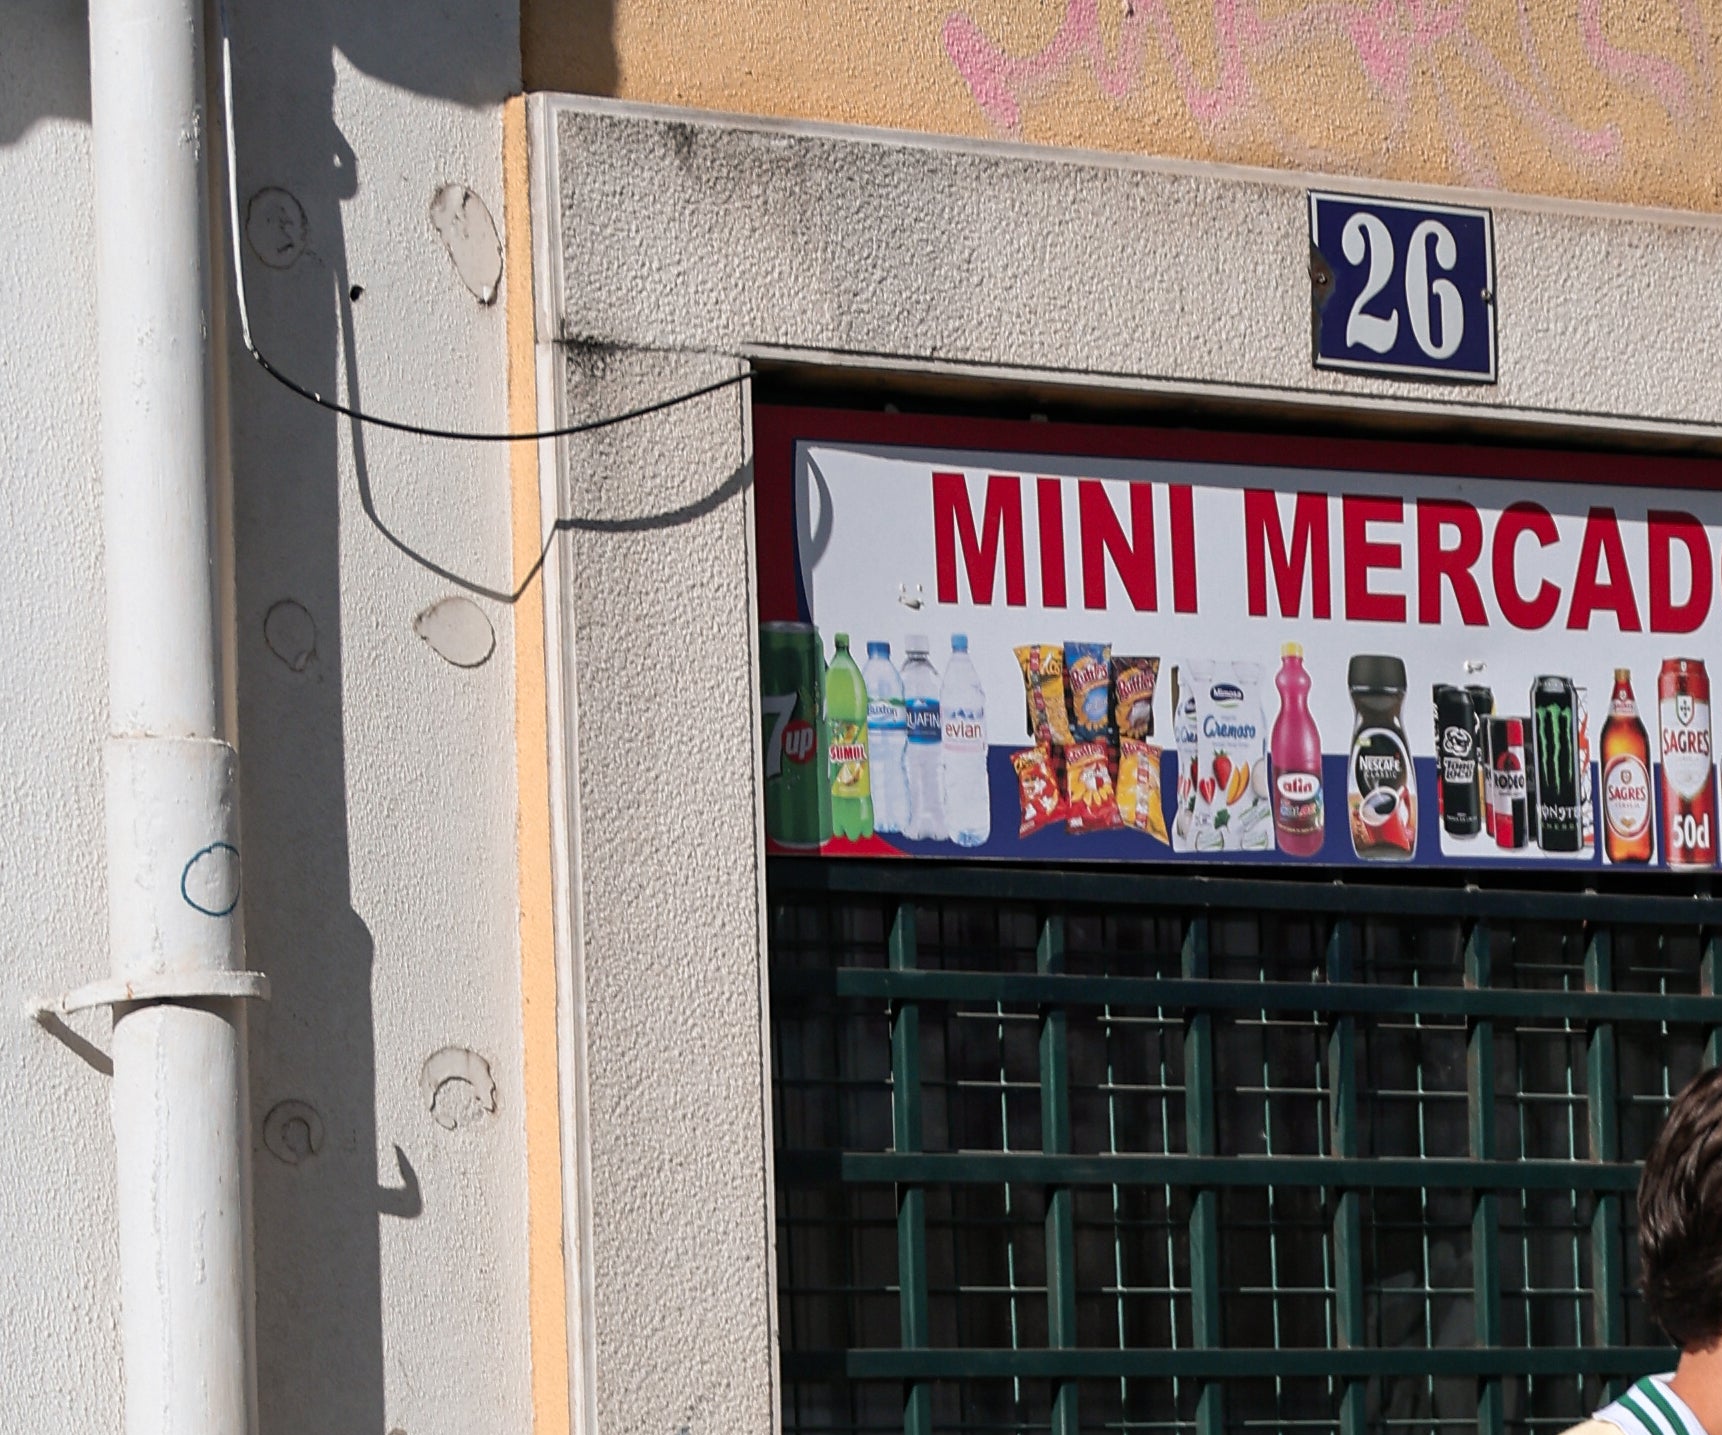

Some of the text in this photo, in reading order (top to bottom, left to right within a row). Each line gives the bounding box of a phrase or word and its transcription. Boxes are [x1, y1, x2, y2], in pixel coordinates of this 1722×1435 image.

[1341, 212, 1464, 360] 26
[932, 472, 1199, 613] MINI
[945, 721, 982, 738] evian
[1203, 713, 1256, 739] Cremoso
[1663, 728, 1710, 756] SAGRES
[1608, 785, 1646, 802] SAGRES
